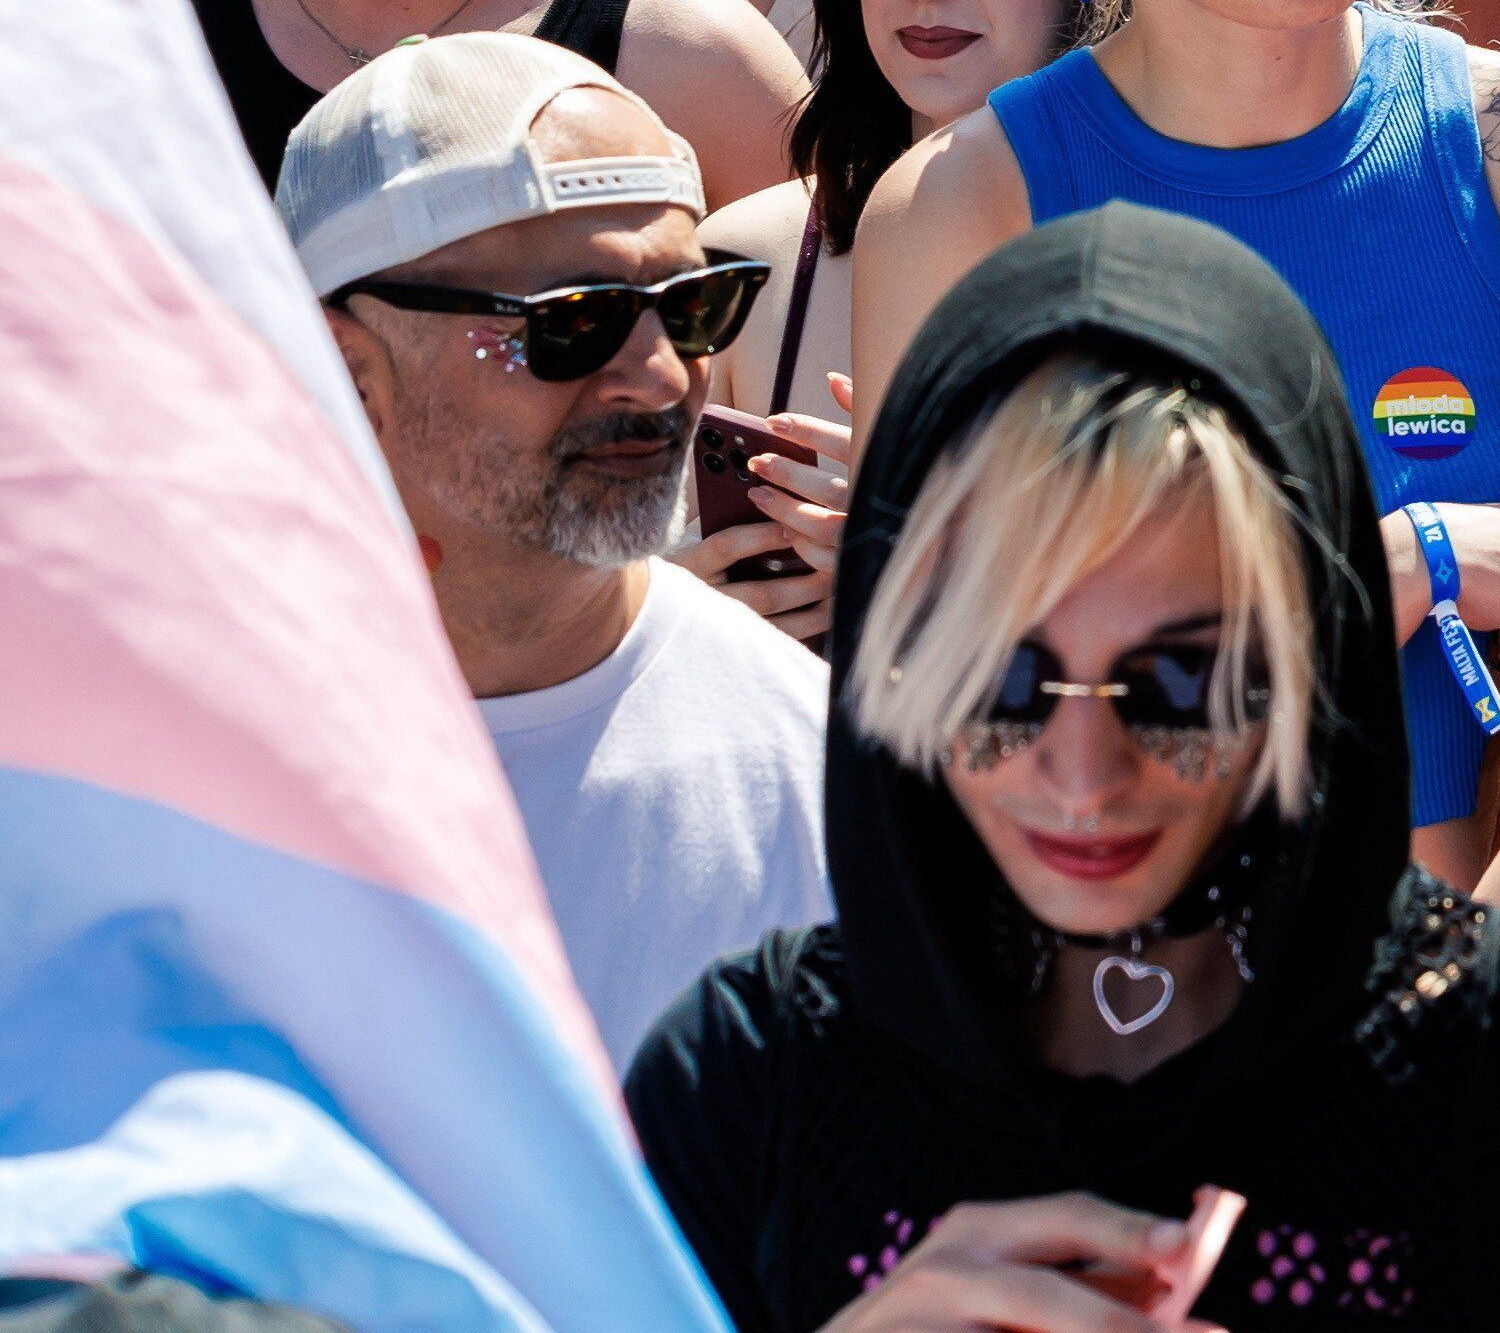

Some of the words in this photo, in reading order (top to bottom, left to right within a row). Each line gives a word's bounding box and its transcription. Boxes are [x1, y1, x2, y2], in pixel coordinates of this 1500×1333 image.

[1386, 394, 1464, 416] młoda
[1387, 414, 1467, 436] lewica
[1453, 646, 1480, 687] MALTA
